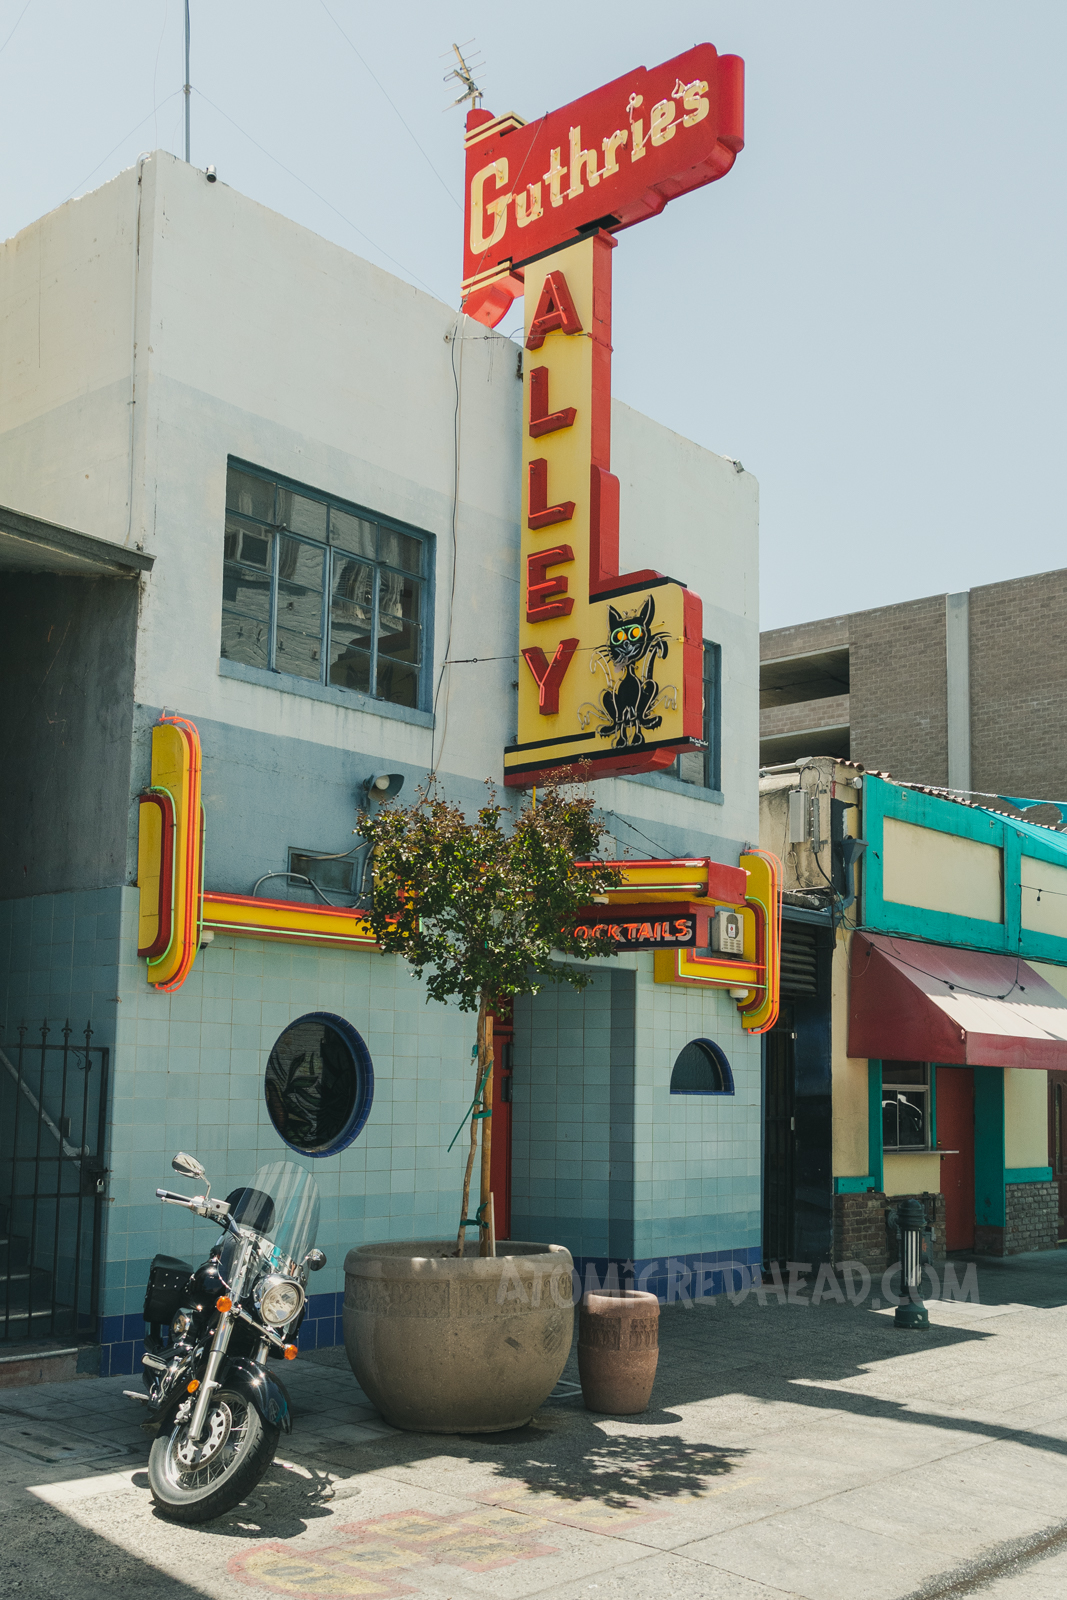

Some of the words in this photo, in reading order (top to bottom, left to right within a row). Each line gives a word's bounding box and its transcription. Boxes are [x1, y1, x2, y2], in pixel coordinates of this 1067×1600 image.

[469, 78, 710, 255] Guthrie's
[521, 269, 584, 715] ALLEY
[560, 919, 693, 943] OCKTAILS
[261, 1565, 338, 1585] 10
